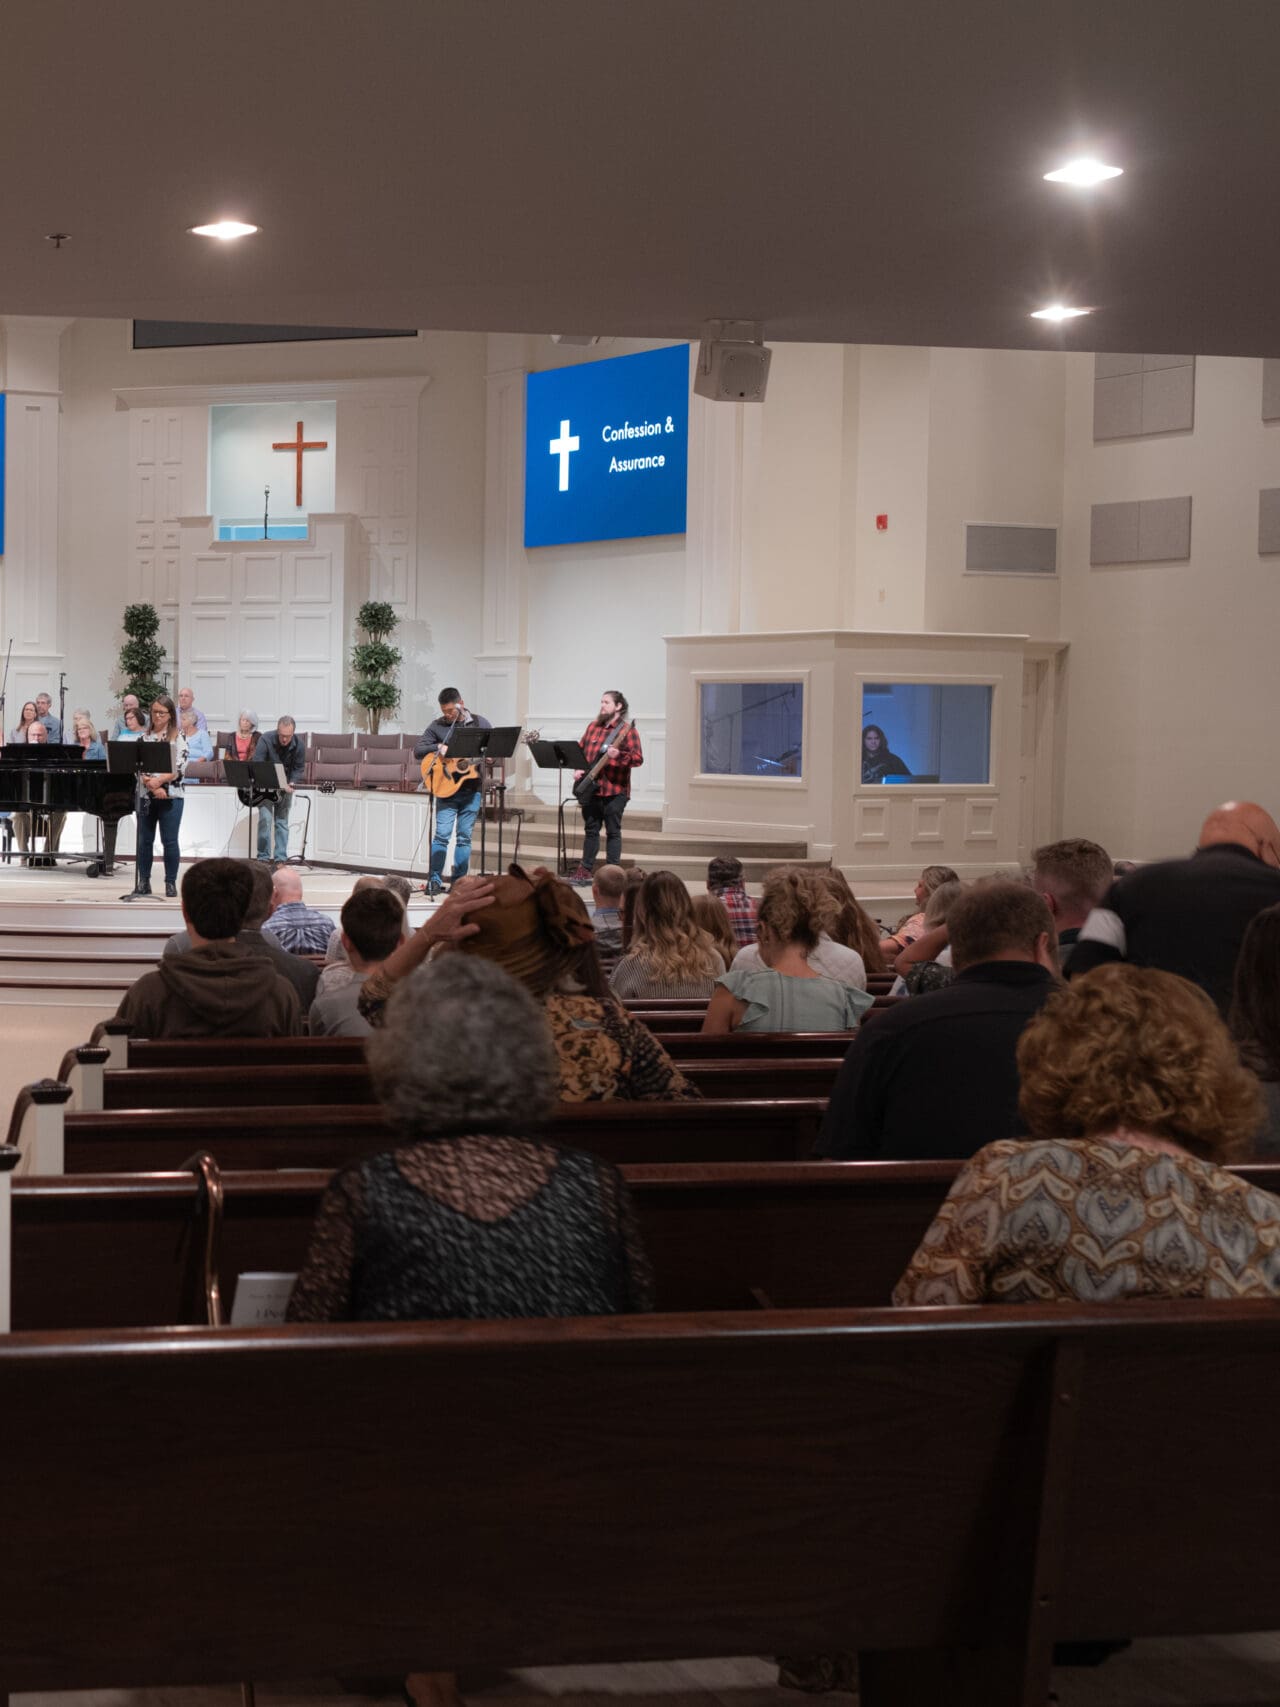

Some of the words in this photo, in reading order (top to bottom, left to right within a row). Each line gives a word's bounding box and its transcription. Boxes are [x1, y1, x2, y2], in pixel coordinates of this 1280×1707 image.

[601, 420, 662, 443] Confession
[664, 415, 675, 434] &
[608, 454, 666, 473] Assurance
